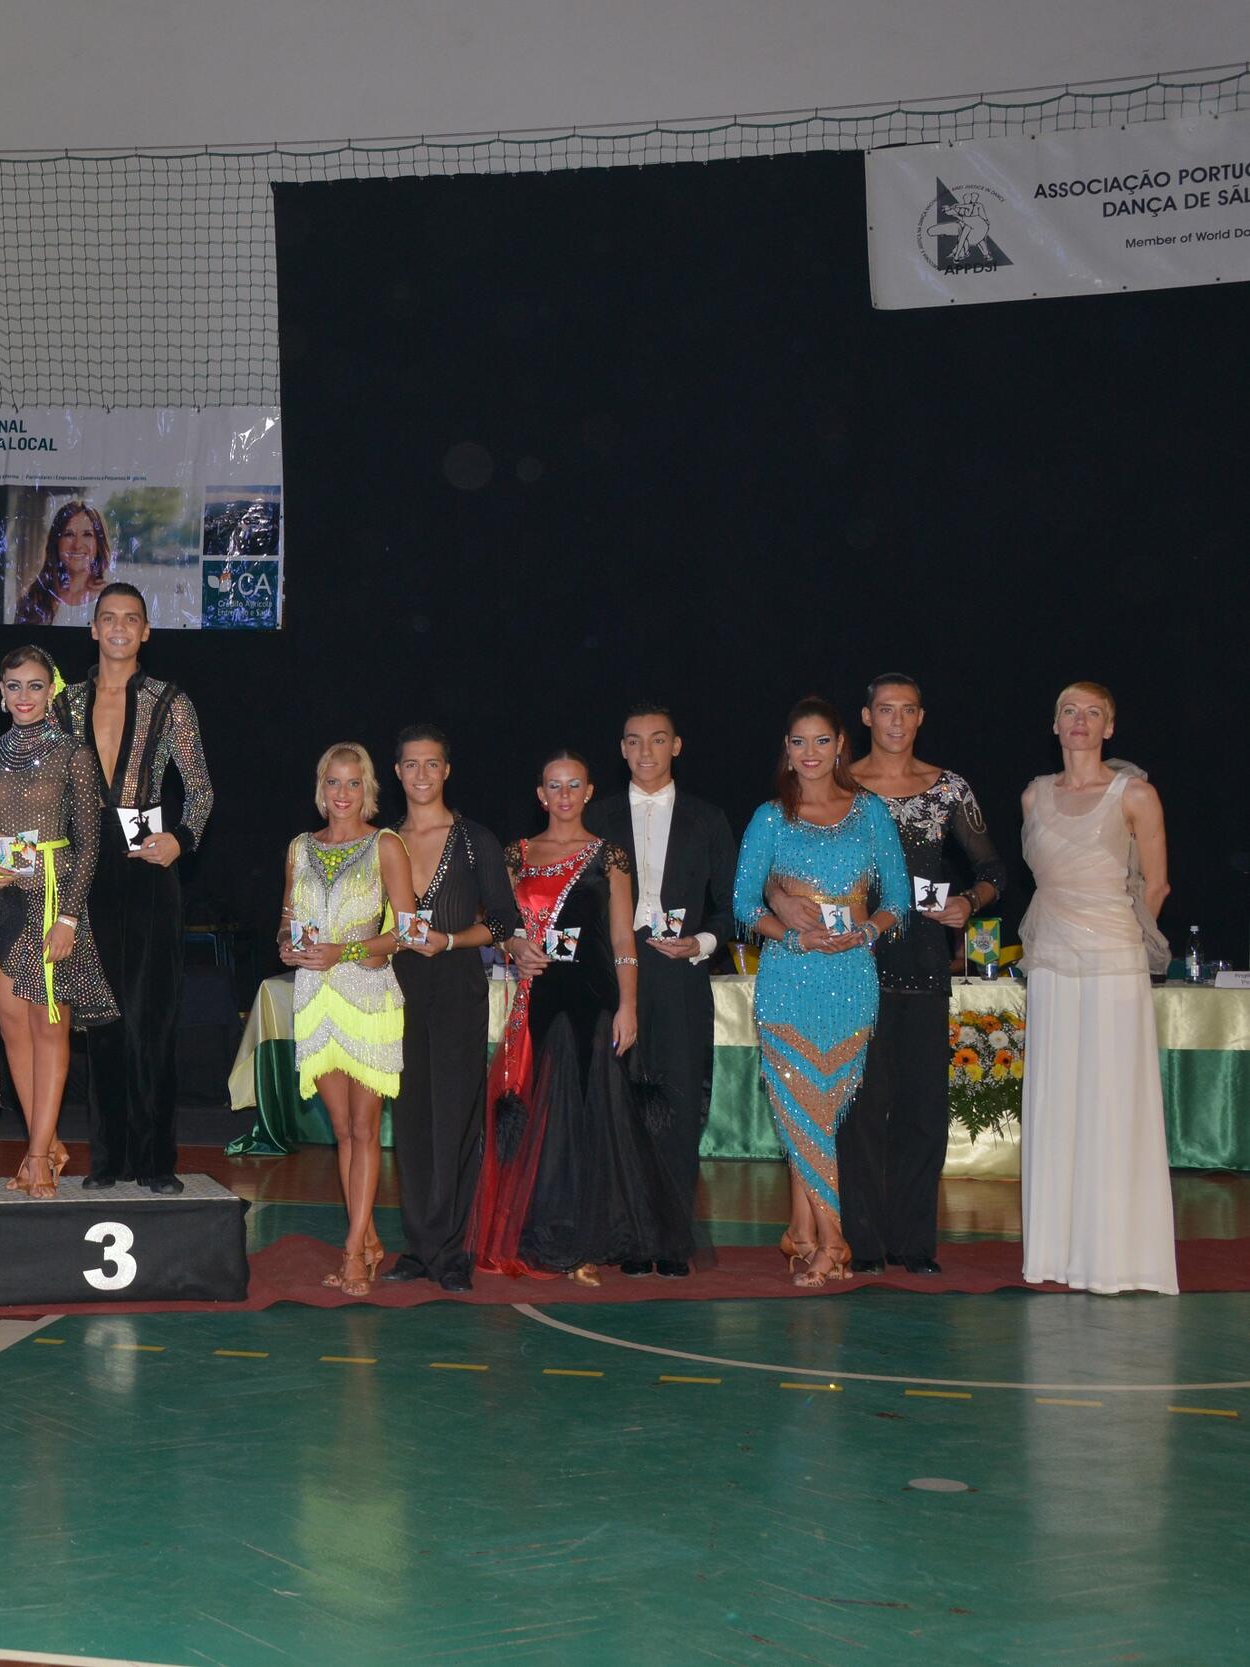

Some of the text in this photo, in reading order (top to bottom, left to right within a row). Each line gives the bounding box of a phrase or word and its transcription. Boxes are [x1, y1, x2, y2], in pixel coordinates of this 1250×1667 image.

[1034, 168, 1171, 199] ASSOCIAÇÃO
[1103, 195, 1178, 217] DANÇA
[1184, 191, 1211, 210] DE
[1125, 234, 1177, 249] Member
[1180, 232, 1192, 243] of
[1195, 228, 1230, 242] World
[9, 437, 57, 451] LOCAL
[238, 573, 271, 595] CA
[83, 1221, 138, 1290] 3
